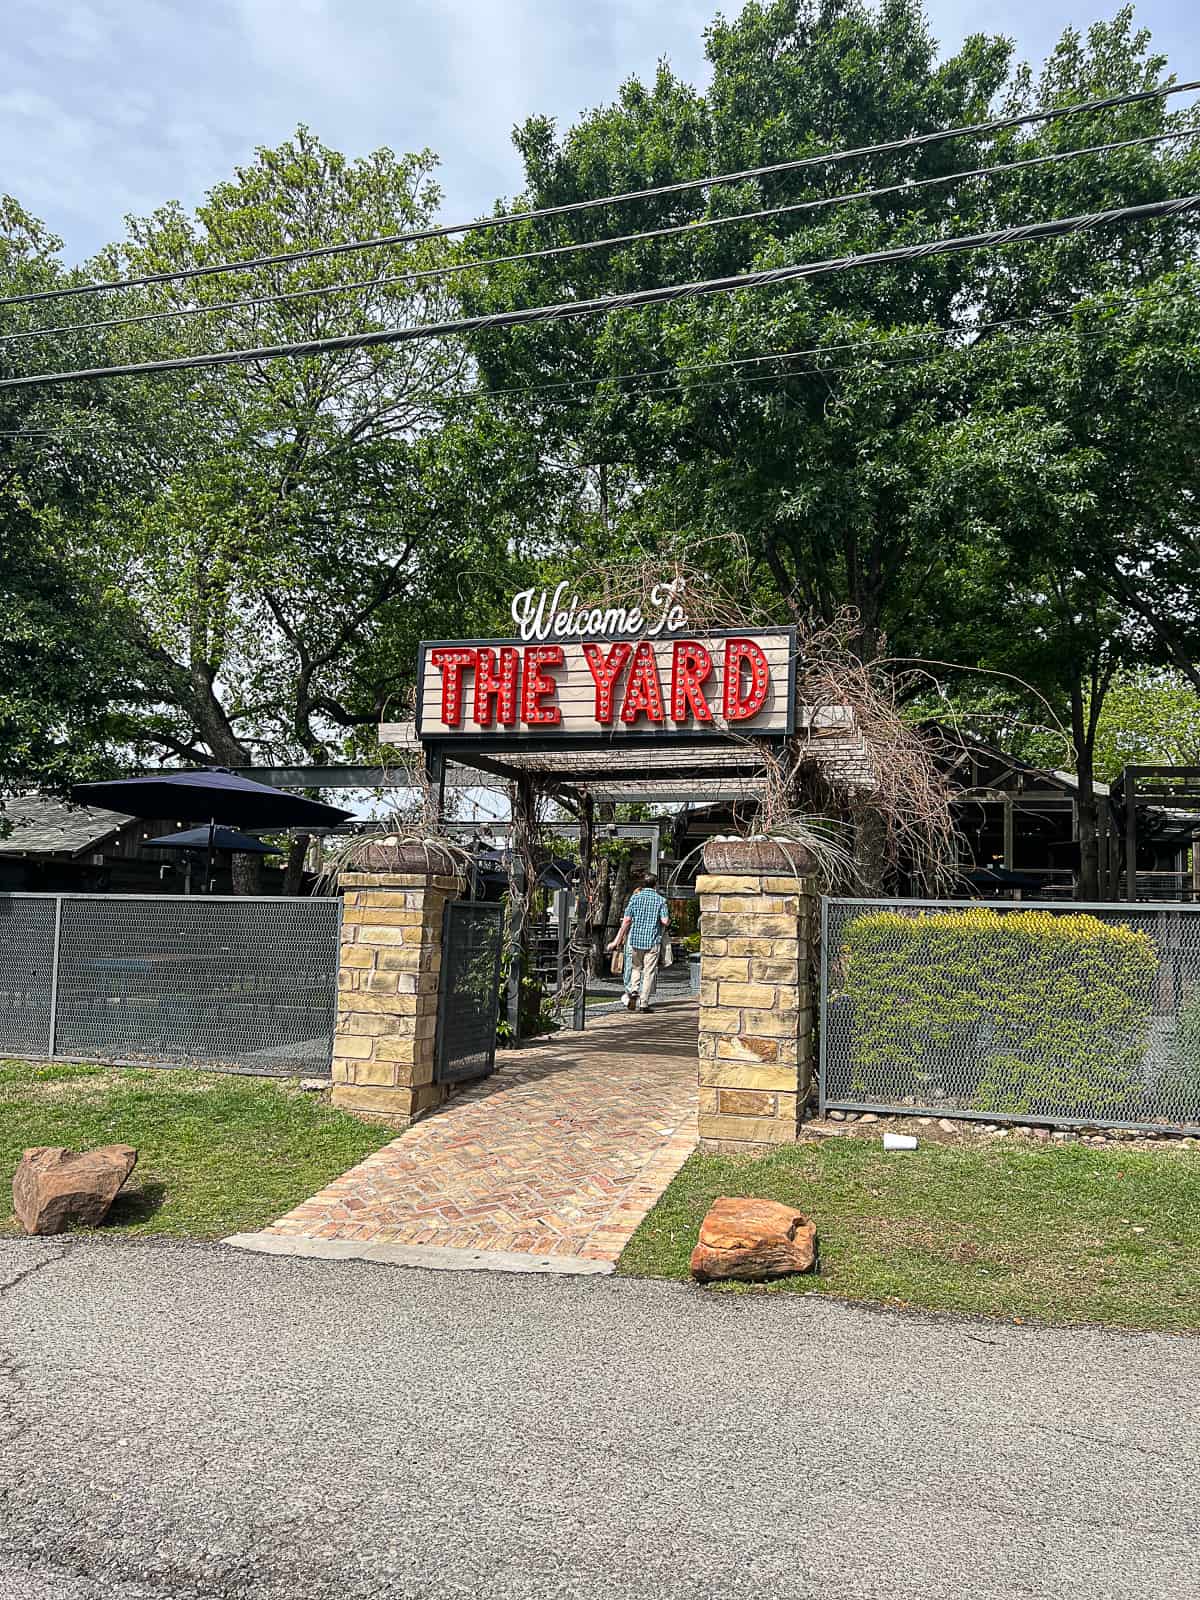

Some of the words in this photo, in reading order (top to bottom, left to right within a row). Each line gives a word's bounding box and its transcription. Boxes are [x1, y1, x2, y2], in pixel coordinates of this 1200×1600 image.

[511, 580, 643, 641] Welcome
[649, 578, 688, 634] To
[431, 645, 564, 726] THE
[582, 638, 770, 725] YARD
